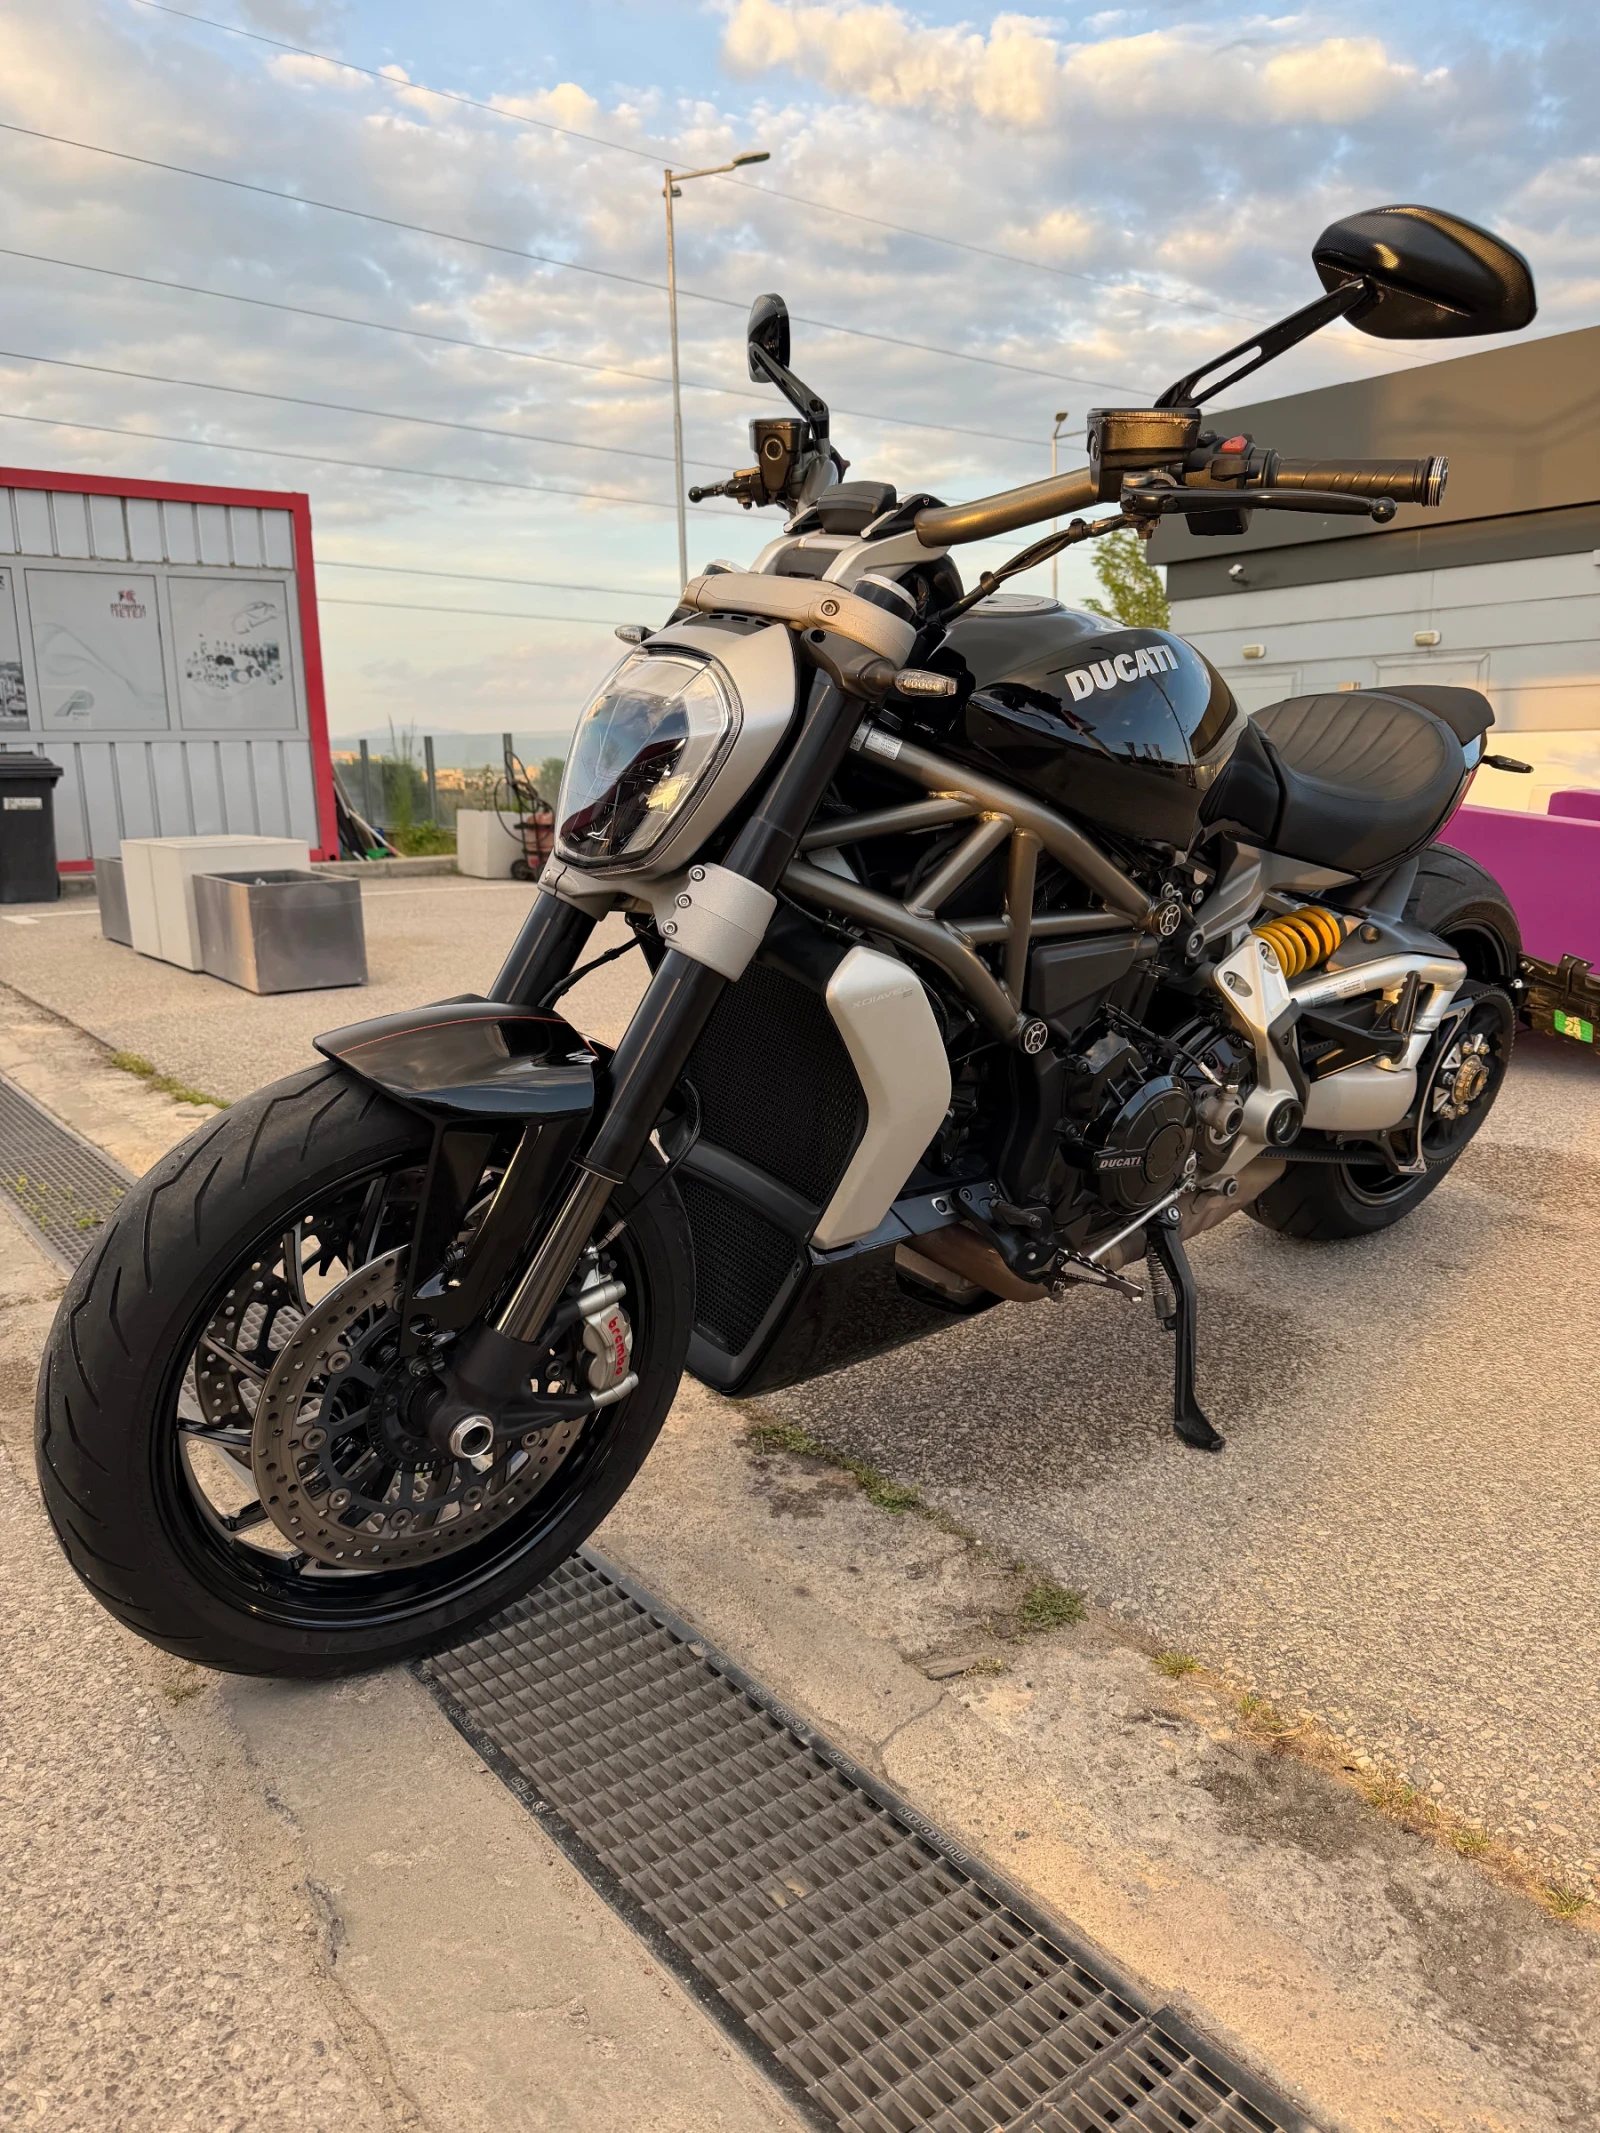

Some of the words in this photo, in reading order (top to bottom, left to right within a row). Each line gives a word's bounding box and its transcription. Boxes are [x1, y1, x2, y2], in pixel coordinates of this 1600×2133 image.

[1064, 644, 1179, 702] DUCATI
[852, 986, 913, 1009] XDIAVEL
[1099, 1156, 1142, 1169] DUCATI
[608, 1315, 628, 1377] brembo
